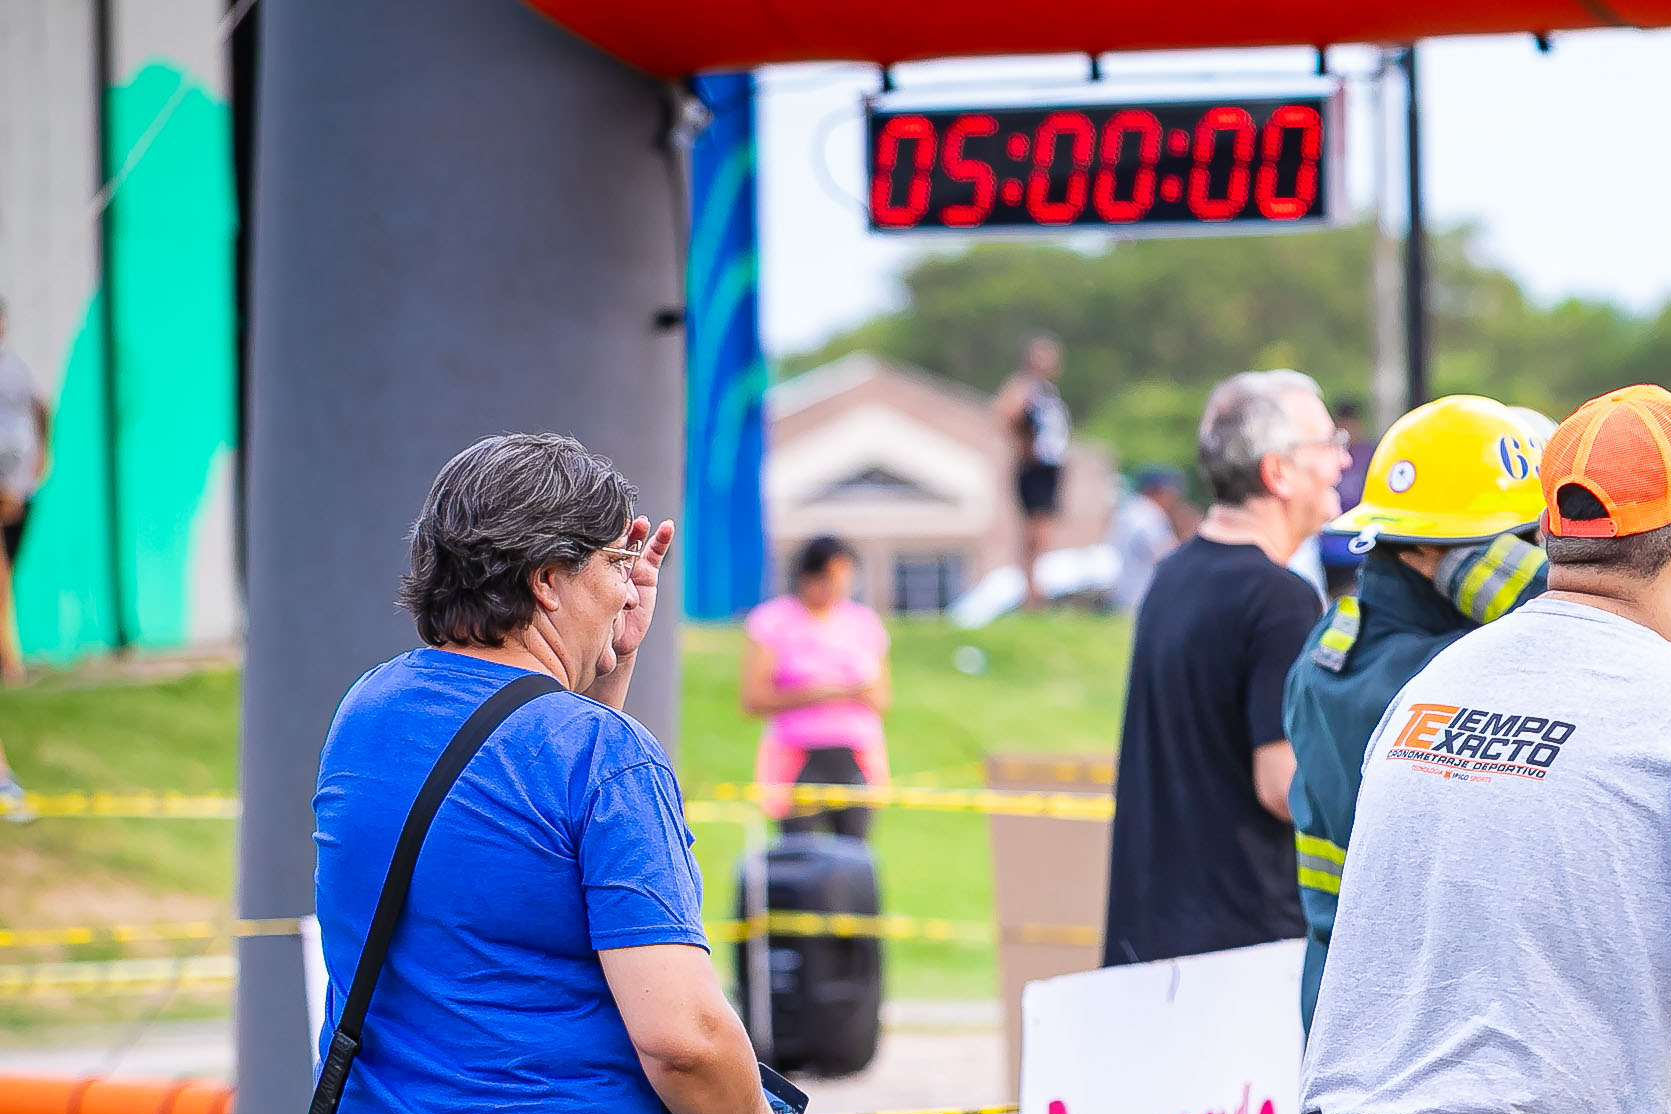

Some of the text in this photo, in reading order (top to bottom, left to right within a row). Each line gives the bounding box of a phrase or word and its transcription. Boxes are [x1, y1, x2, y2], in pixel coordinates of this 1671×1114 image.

[869, 105, 1323, 229] 05:00:00
[1393, 703, 1576, 746] TIEMPO
[1404, 713, 1560, 768] EXACTO
[1386, 749, 1547, 779] CRONOMETRAJE DEPORTIVO
